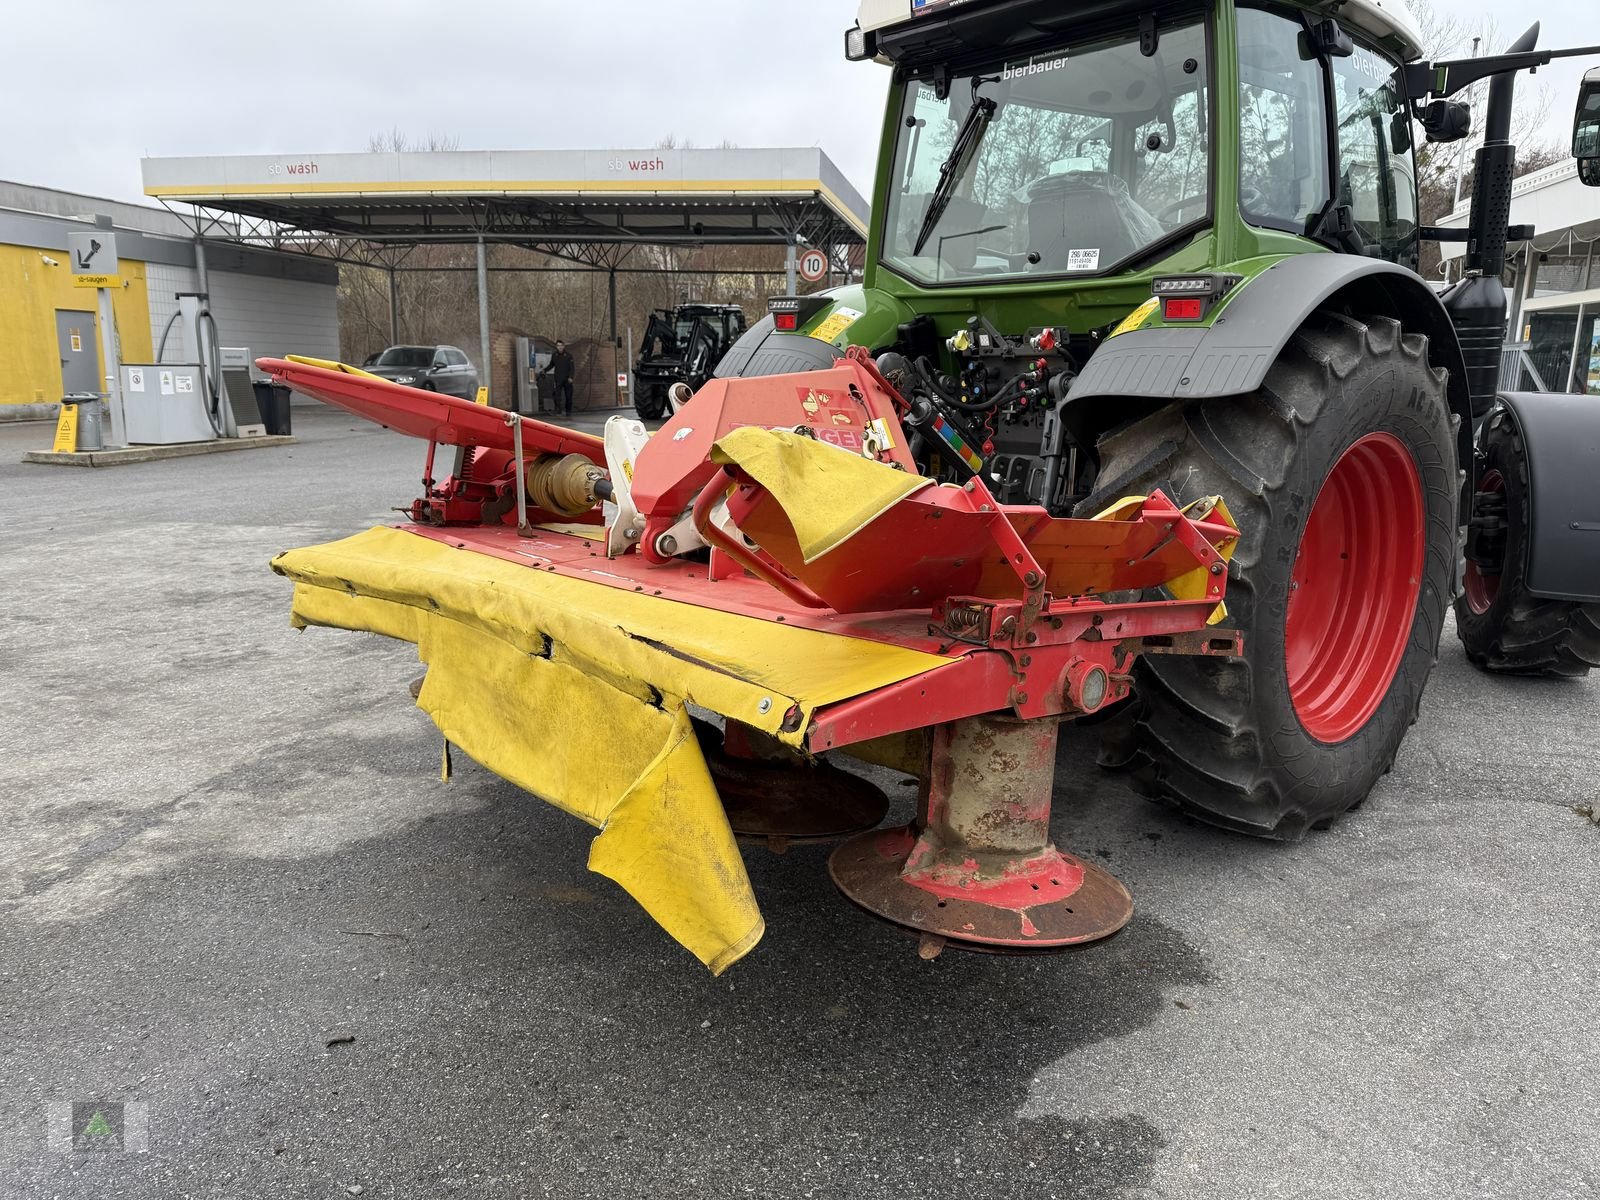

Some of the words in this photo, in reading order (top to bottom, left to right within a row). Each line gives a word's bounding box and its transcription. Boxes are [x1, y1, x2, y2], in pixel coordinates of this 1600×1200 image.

[1003, 56, 1068, 80] bierbauer
[1352, 50, 1397, 94] bierbauer
[269, 163, 281, 175] sb
[286, 161, 318, 174] wash
[609, 157, 623, 170] sb
[628, 156, 664, 171] wash
[807, 258, 820, 272] 10
